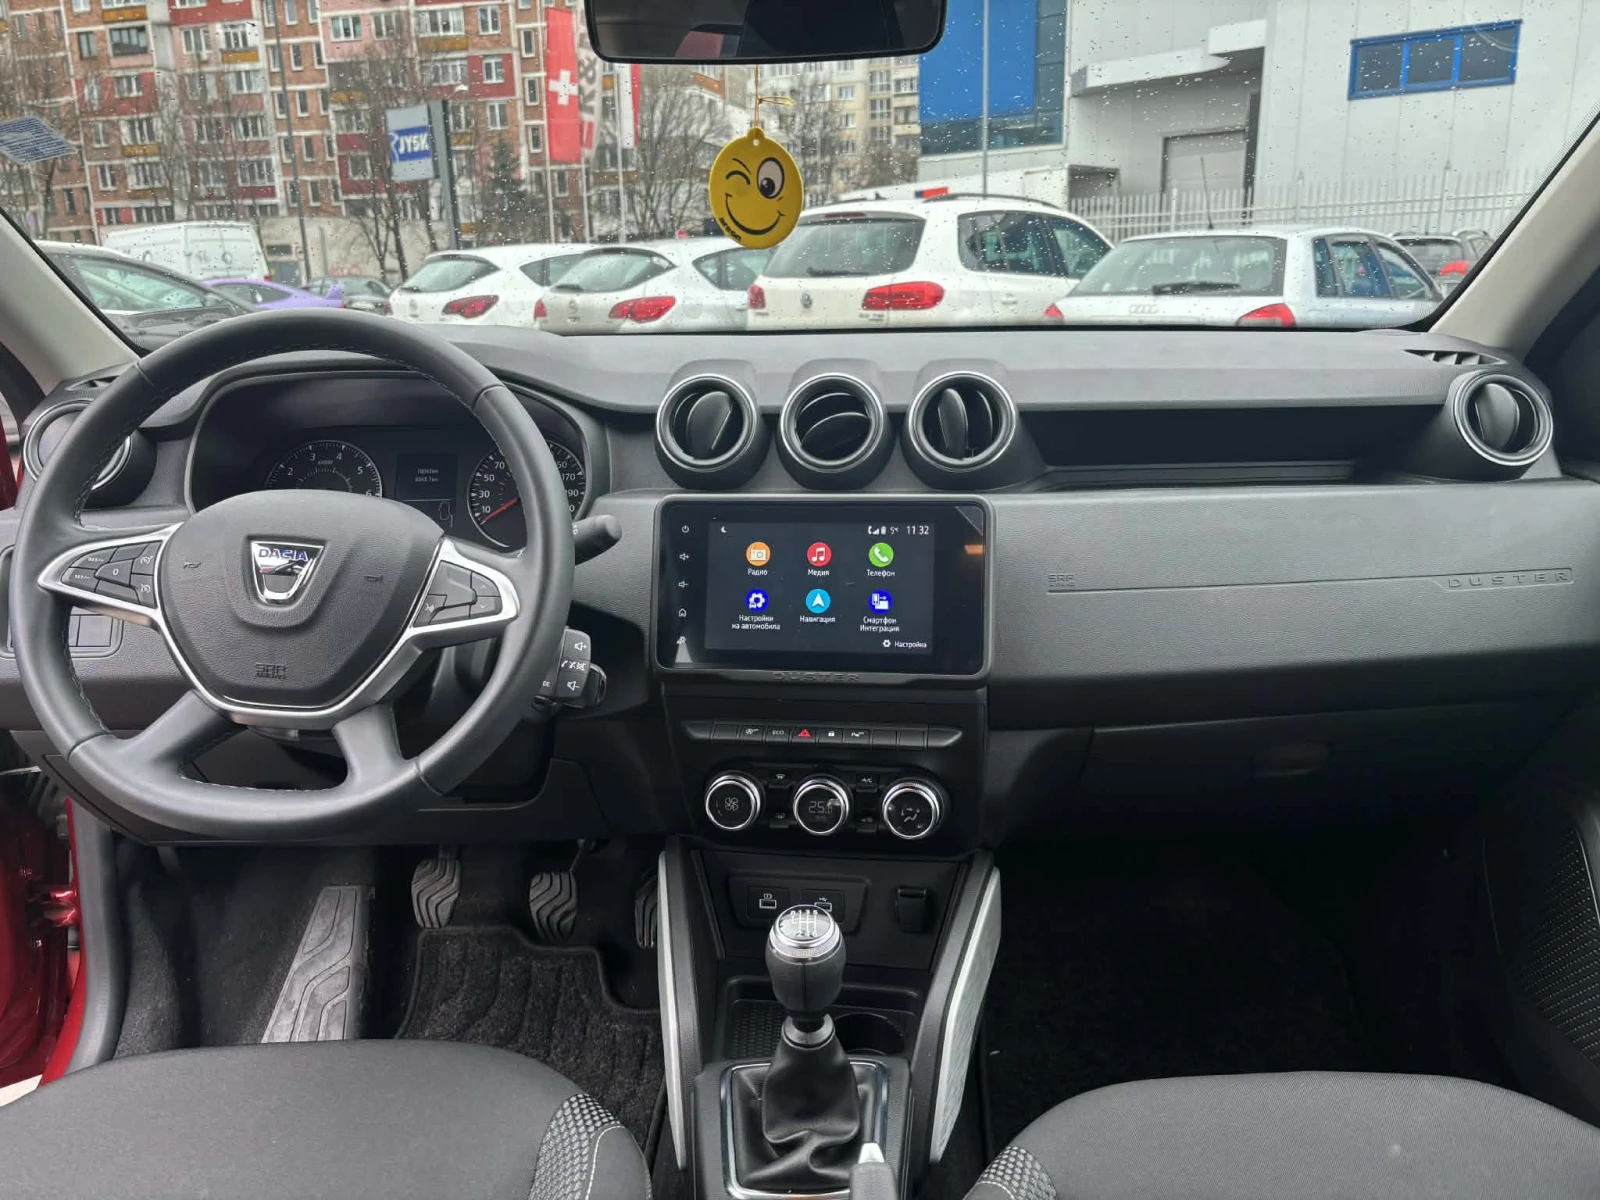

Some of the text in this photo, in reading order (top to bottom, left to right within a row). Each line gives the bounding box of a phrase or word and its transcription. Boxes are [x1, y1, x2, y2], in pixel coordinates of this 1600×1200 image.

[398, 131, 430, 154] JYSK
[309, 452, 316, 461] 3
[335, 452, 343, 461] 4
[494, 461, 506, 470] 70
[556, 461, 568, 469] 50
[287, 467, 294, 476] 2
[357, 466, 363, 475] 5
[483, 474, 495, 482] 50
[479, 490, 490, 499] 30
[482, 505, 491, 514] 10
[747, 568, 768, 576] Радио
[807, 568, 830, 577] Медия
[866, 569, 896, 578] Телефон
[1448, 572, 1569, 587] DUSTER
[738, 614, 774, 623] Настройки
[799, 615, 836, 623] Навигация
[862, 616, 897, 626] Смартфон
[741, 622, 781, 630] автомобила
[859, 624, 900, 633] Интеграция
[894, 641, 927, 649] Настройка
[773, 671, 860, 682] DUSTER
